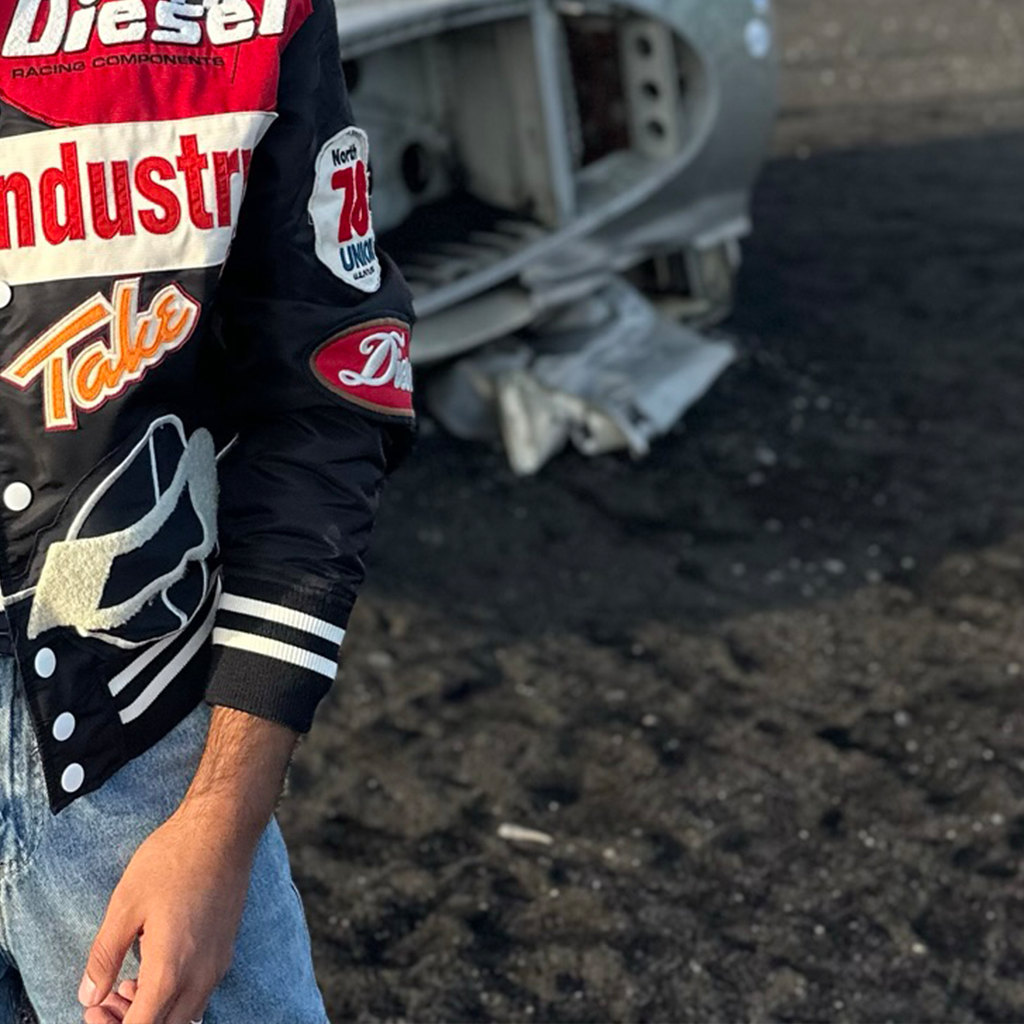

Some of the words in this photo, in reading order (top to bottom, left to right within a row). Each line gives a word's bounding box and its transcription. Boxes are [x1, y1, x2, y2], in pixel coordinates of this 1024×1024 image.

[11, 61, 86, 79] RACING
[92, 53, 225, 68] COMPONENTS
[0, 277, 199, 429] Take
